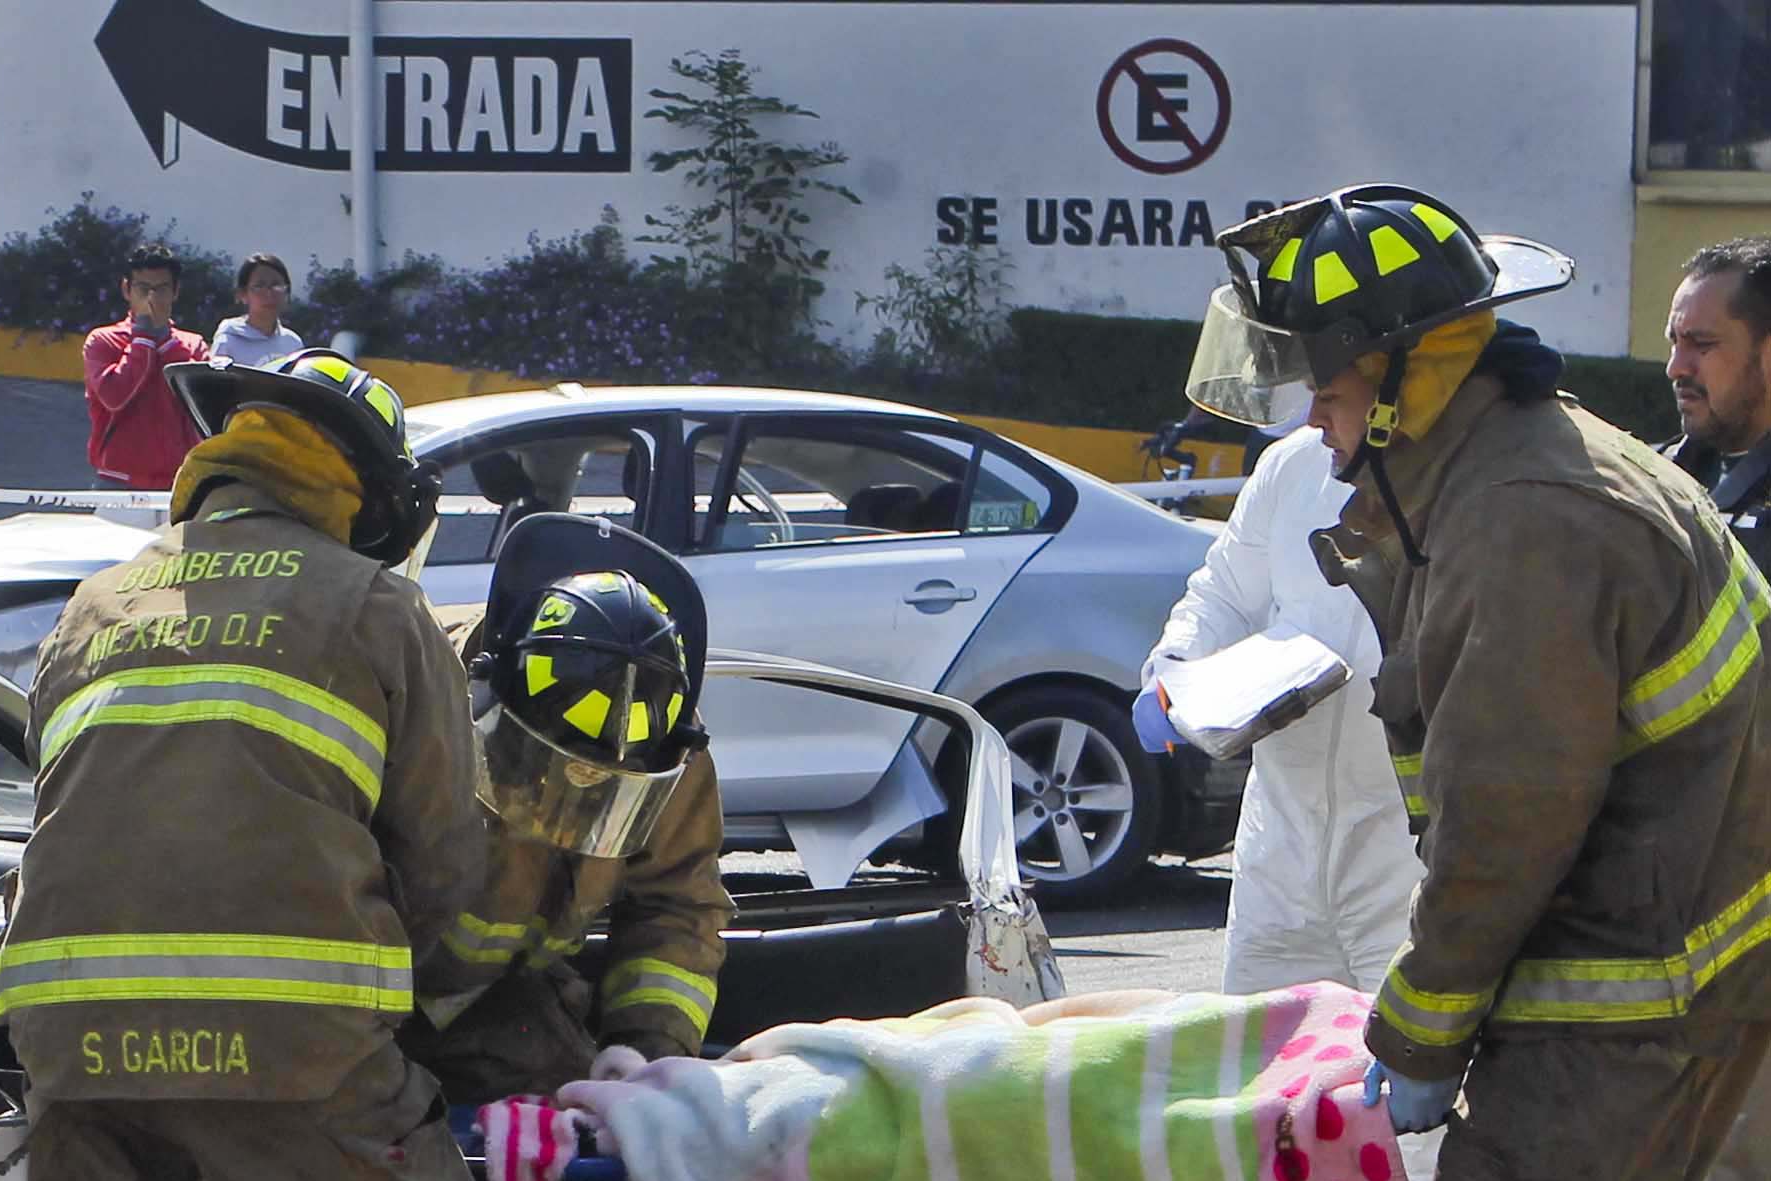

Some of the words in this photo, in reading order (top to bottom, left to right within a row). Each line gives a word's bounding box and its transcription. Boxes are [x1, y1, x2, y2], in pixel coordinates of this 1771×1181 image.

[266, 46, 617, 153] ENTRADA
[936, 196, 998, 247] SE
[1025, 198, 1216, 248] USARA
[115, 550, 304, 594] BOMBEROS
[85, 615, 212, 667] MEXICO
[220, 612, 284, 655] D.F.
[82, 1031, 112, 1076] S.
[122, 1029, 250, 1075] GARCIA
